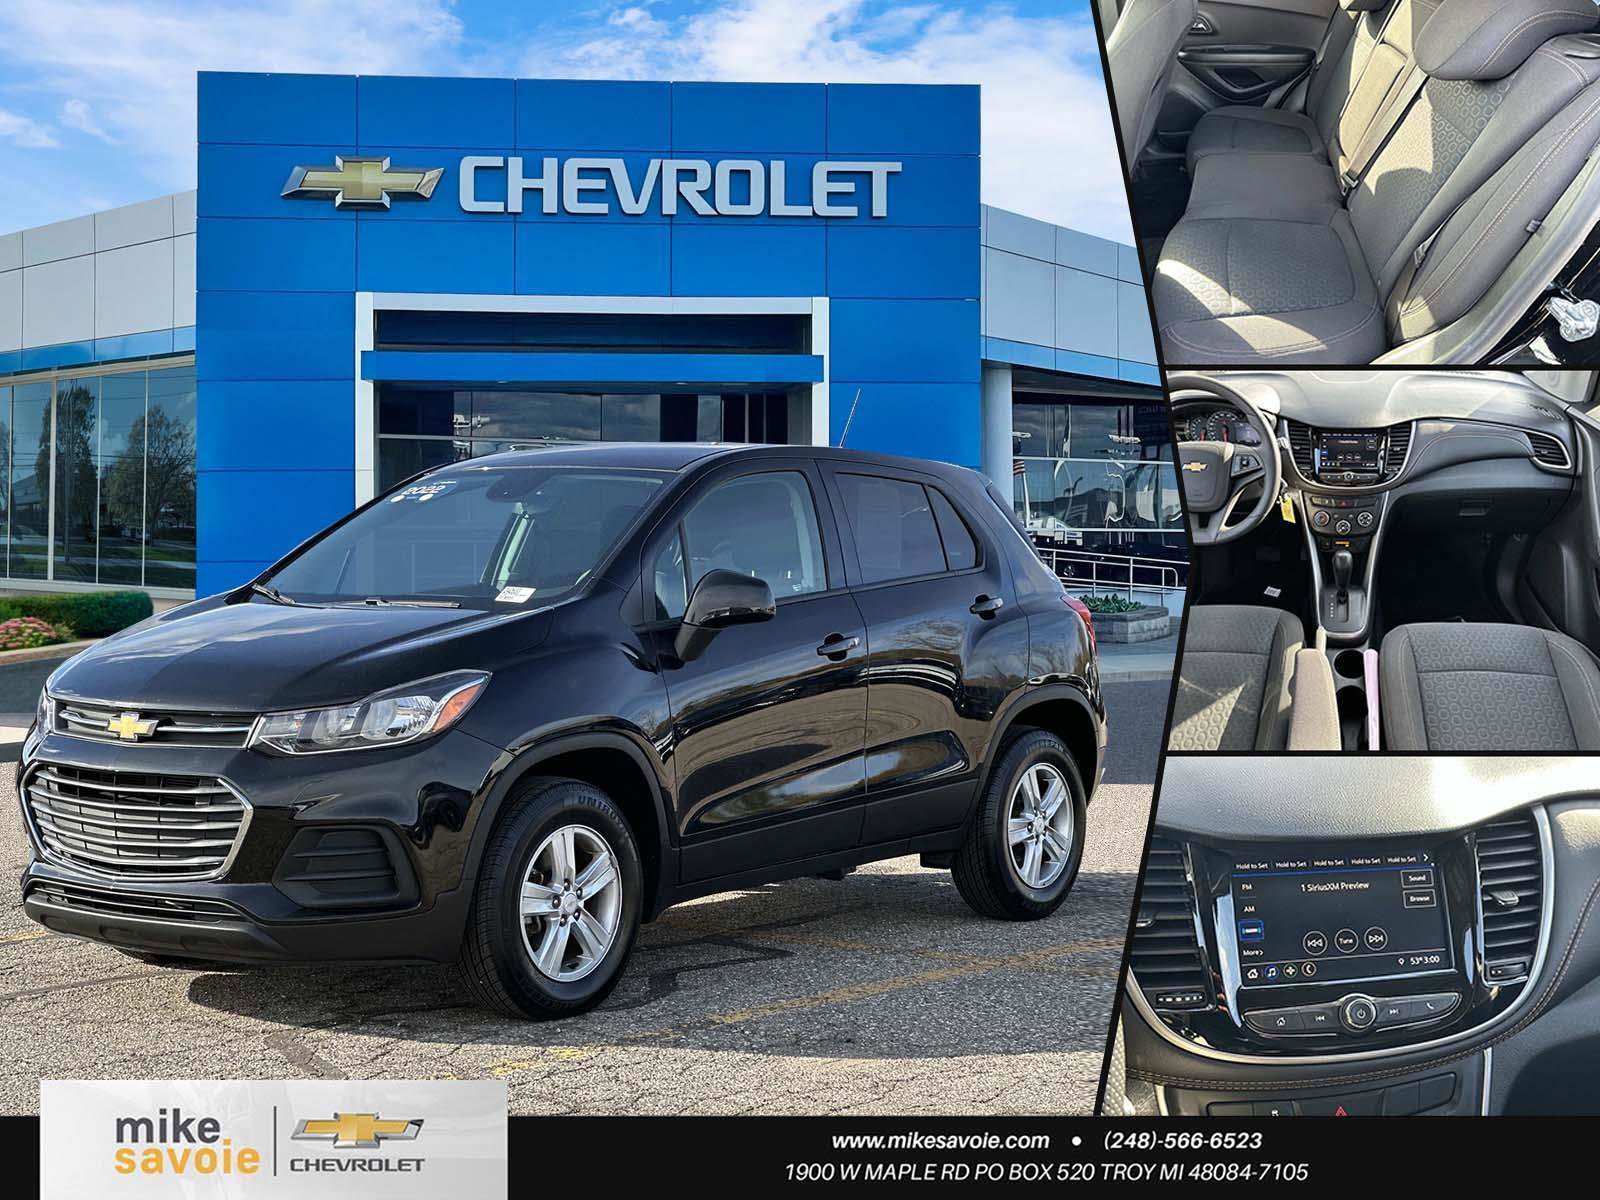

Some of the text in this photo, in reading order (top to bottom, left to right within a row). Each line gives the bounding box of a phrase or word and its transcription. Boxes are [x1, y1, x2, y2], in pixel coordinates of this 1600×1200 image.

[459, 156, 902, 218] CHEVROLET
[1307, 882, 1339, 891] SiriusXM
[1340, 881, 1370, 889] Preview
